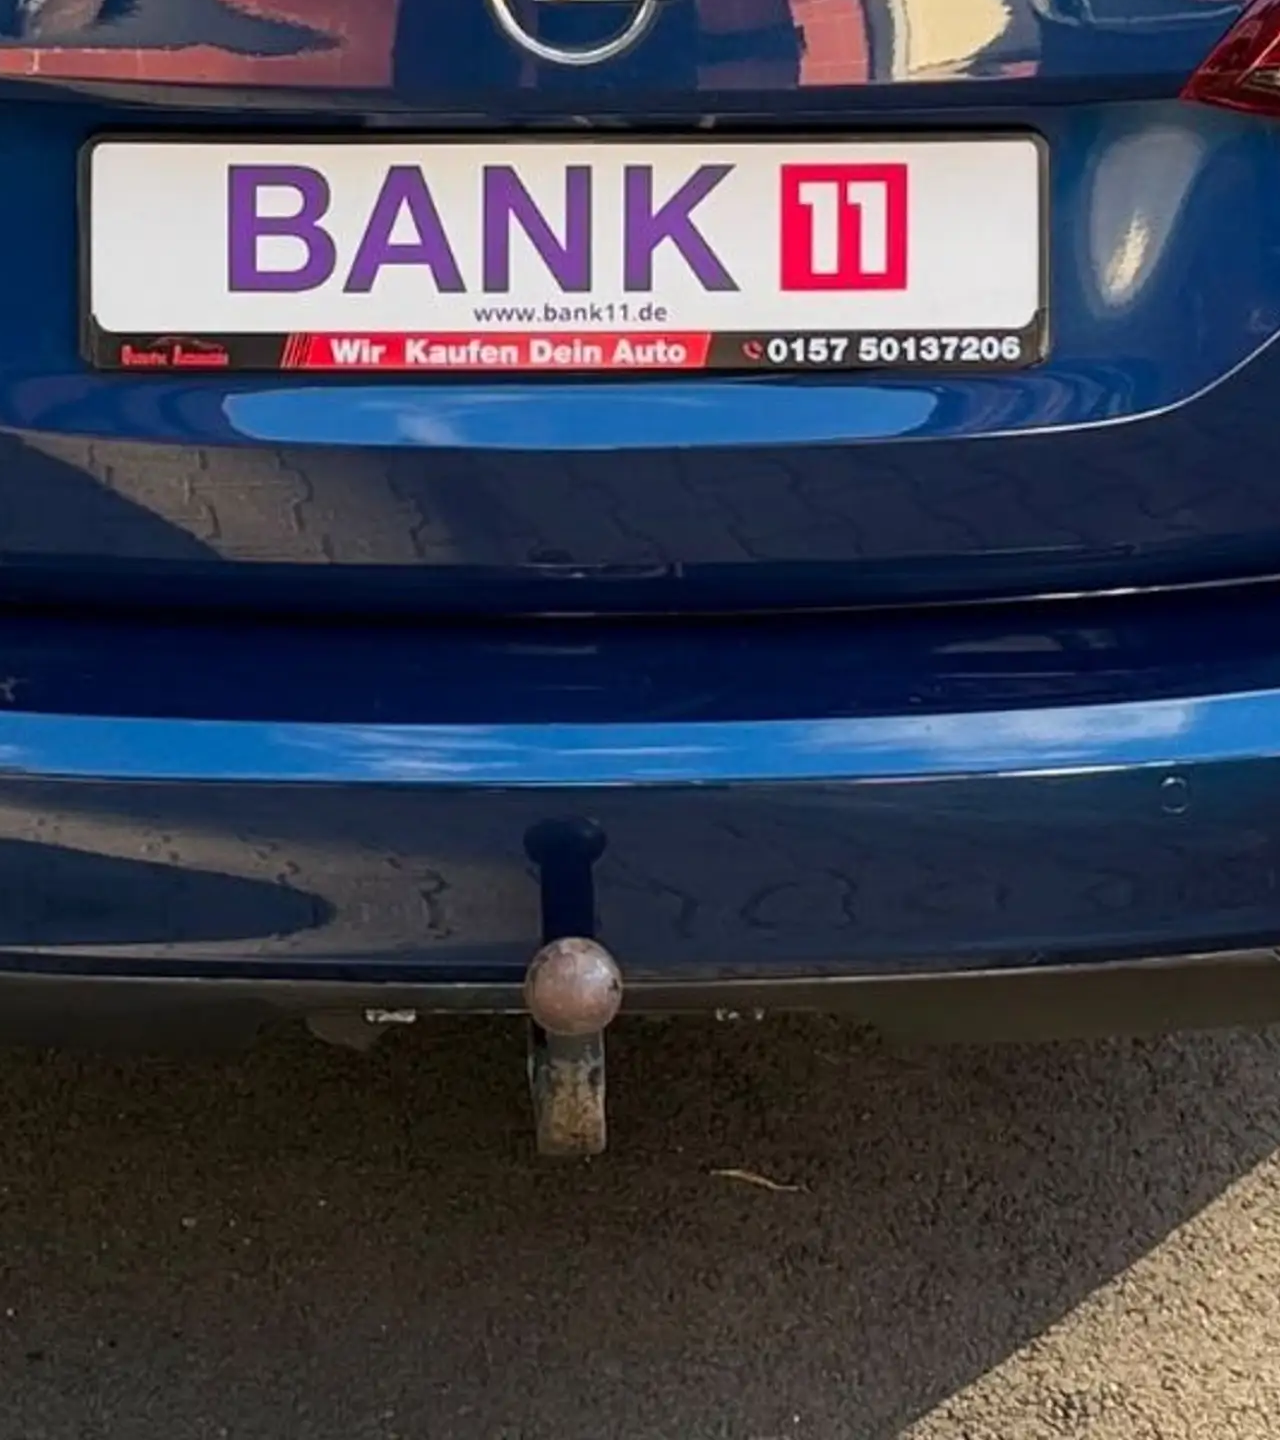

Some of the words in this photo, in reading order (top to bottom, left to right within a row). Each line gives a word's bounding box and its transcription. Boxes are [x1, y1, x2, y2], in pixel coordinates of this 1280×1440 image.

[226, 163, 741, 294] BANK
[797, 180, 889, 276] 11
[473, 303, 668, 324] www.bank11.de
[330, 337, 386, 365] Wir
[405, 338, 518, 366] Kaufen
[529, 338, 602, 365] Dein
[612, 337, 688, 365] Auto
[768, 338, 848, 363] 0157
[858, 335, 1021, 362] 50137206
